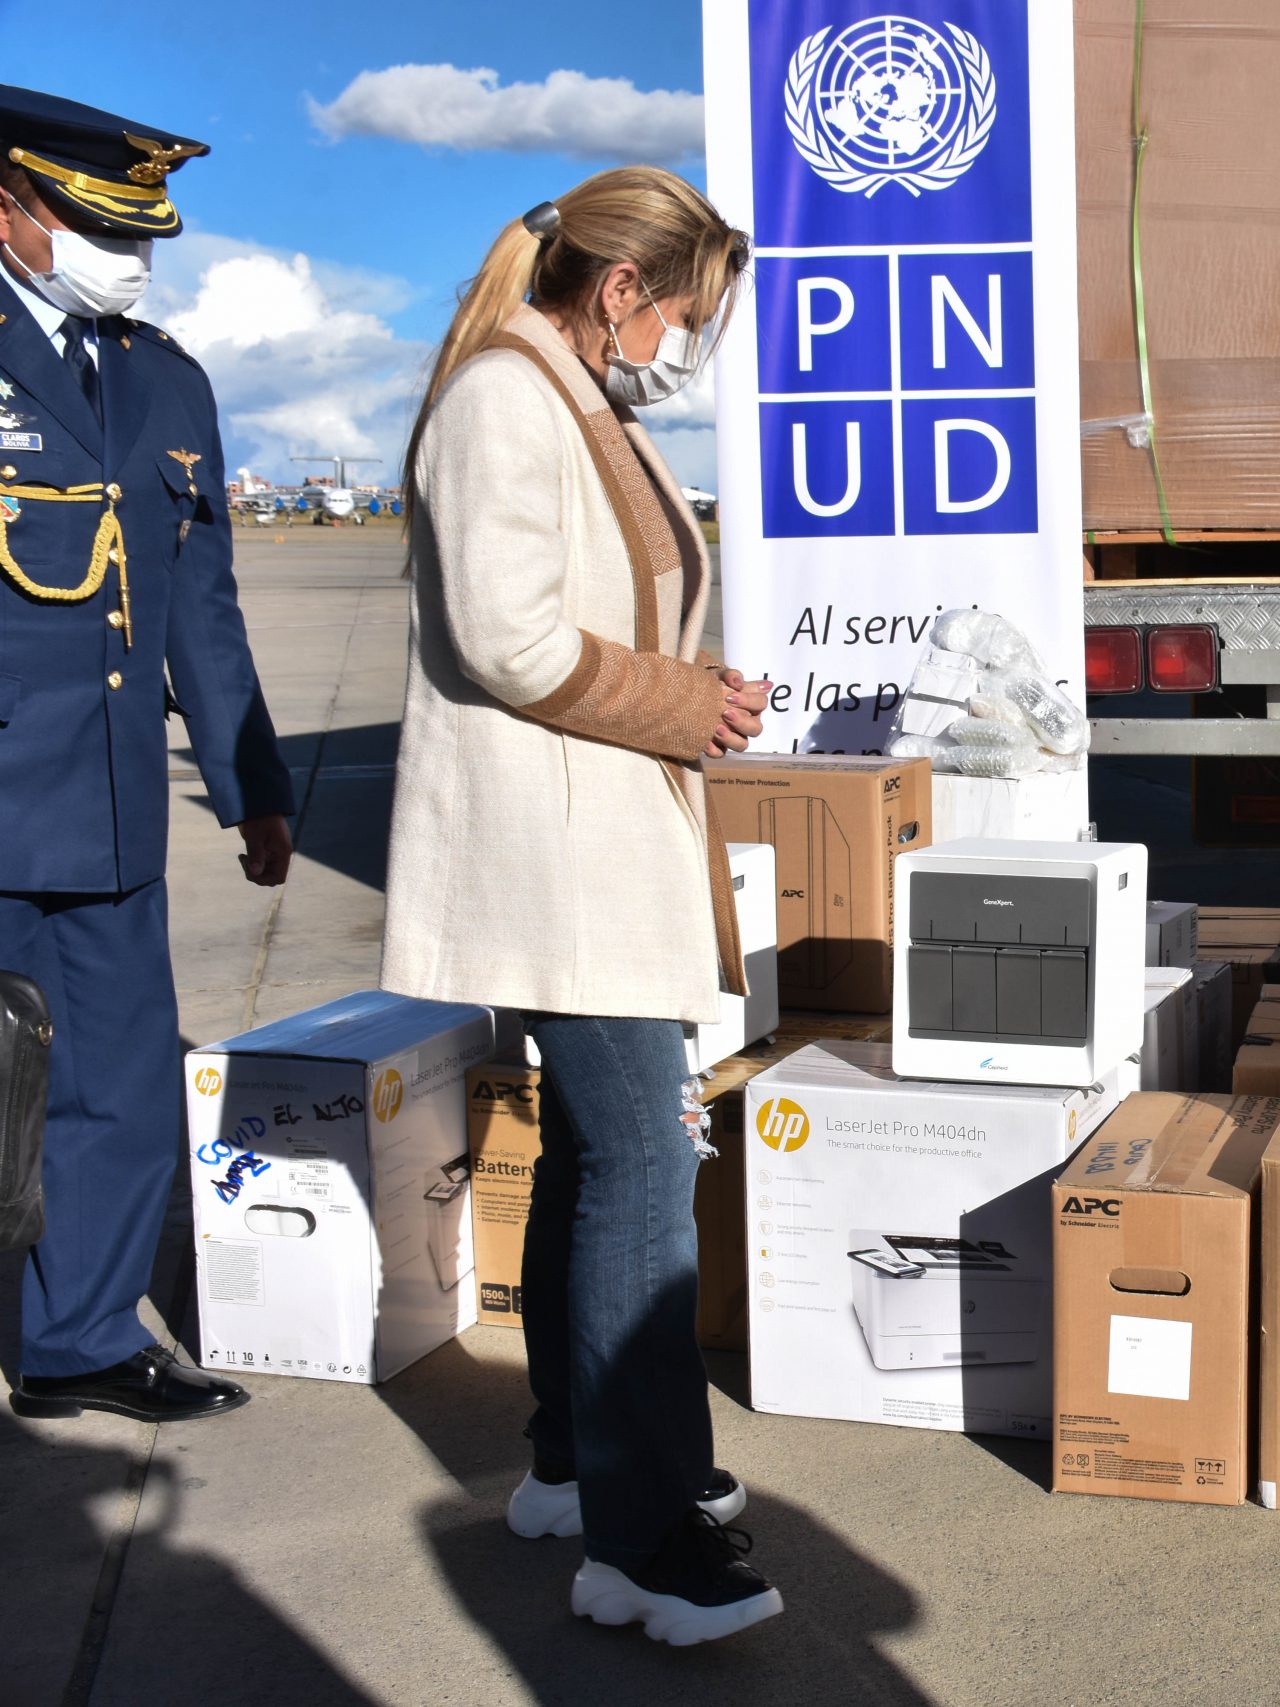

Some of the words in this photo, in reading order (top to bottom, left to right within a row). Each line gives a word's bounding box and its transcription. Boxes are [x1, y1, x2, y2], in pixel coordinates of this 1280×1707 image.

[789, 604, 833, 646] Al
[803, 671, 862, 713] las
[735, 778, 756, 786] Power
[757, 779, 791, 787] Protection
[883, 776, 901, 794] APC
[781, 889, 805, 898] APC
[195, 1067, 222, 1096] hp
[472, 1080, 534, 1103] APC
[373, 1068, 403, 1123] hp
[273, 1103, 303, 1126] EL
[757, 1097, 809, 1152] hp
[826, 1116, 889, 1135] LaserJet
[893, 1121, 919, 1137] Pro
[923, 1123, 987, 1141] M404dn
[197, 1116, 267, 1165] COVID
[827, 1139, 842, 1148] The
[843, 1140, 865, 1150] smart
[866, 1141, 891, 1152] choice
[892, 1143, 903, 1153] for
[904, 1145, 918, 1154] the
[919, 1146, 960, 1157] productive
[961, 1149, 982, 1159] office
[1061, 1196, 1120, 1216] APC
[1068, 1220, 1097, 1228] Schneider
[242, 1352, 254, 1361] 10
